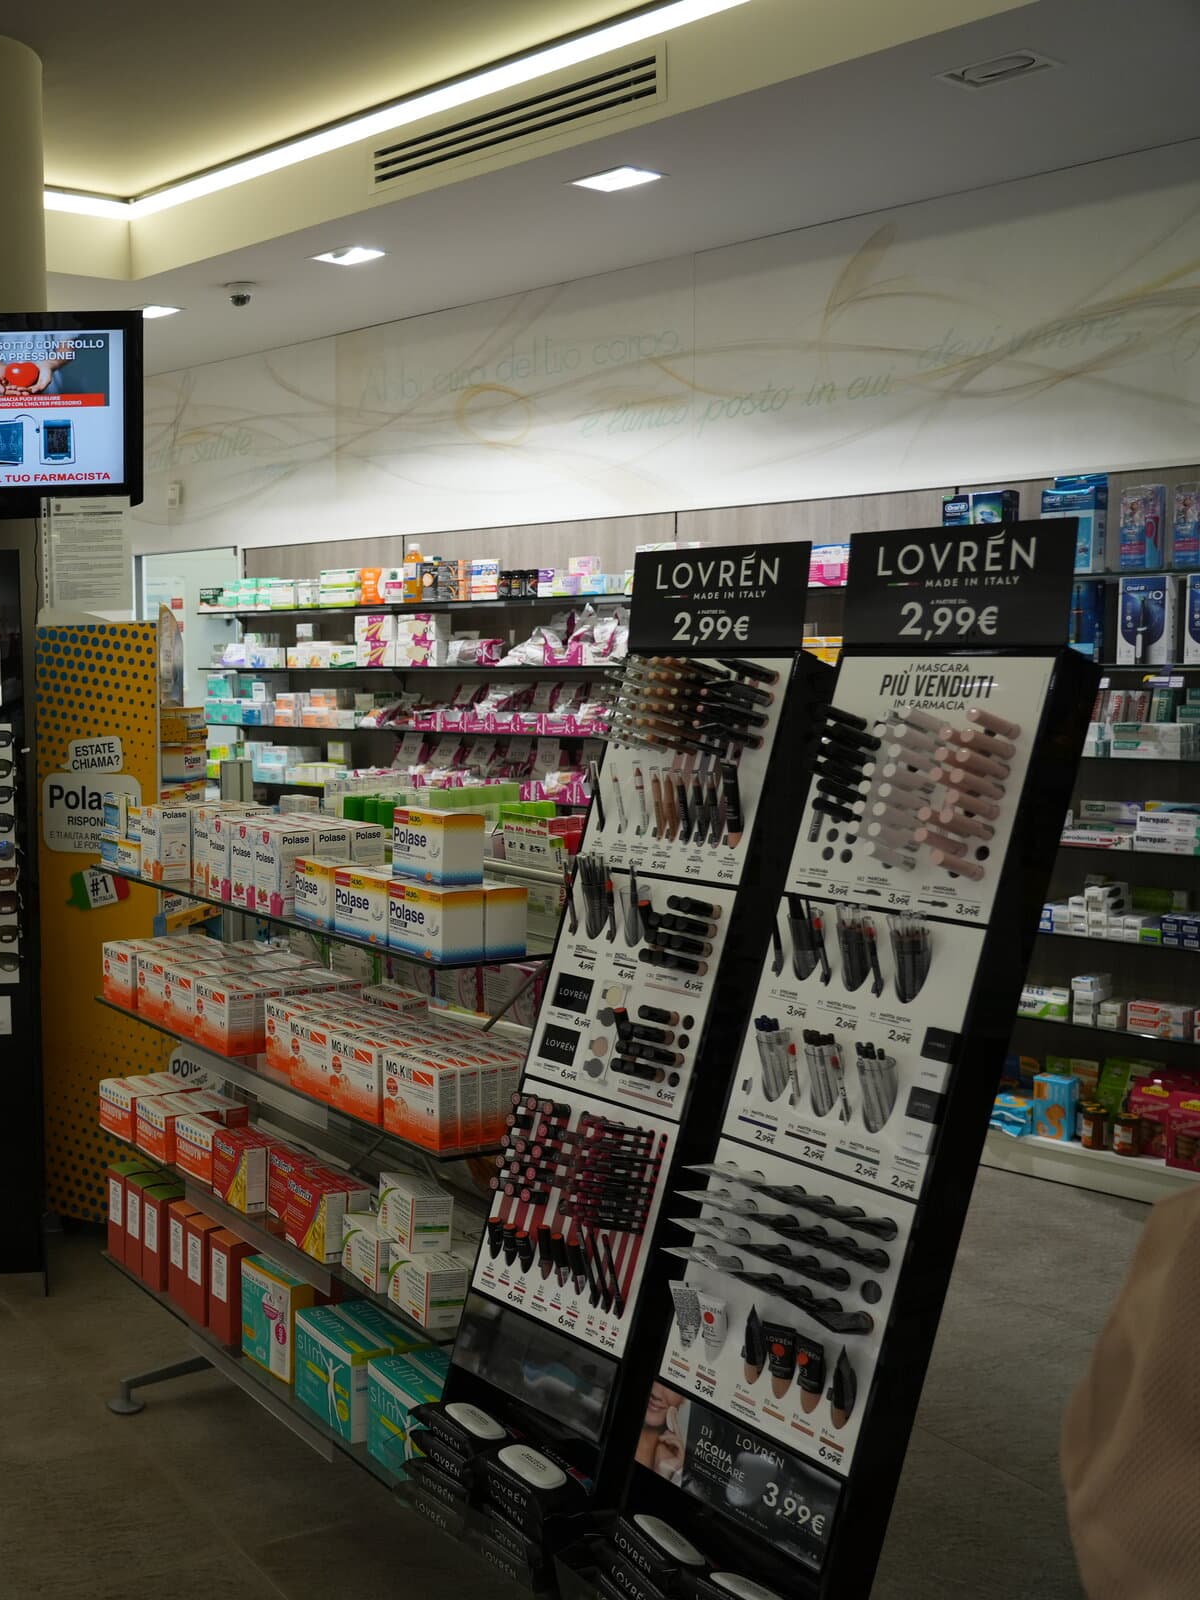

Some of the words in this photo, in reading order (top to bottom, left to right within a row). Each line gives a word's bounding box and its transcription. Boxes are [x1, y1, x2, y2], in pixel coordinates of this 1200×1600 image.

[35, 338, 104, 351] CONTROLLO
[7, 350, 76, 362] PRESSIONE!
[802, 374, 836, 407] in
[5, 473, 31, 483] TUO
[33, 472, 111, 483] FARMACISTA
[877, 529, 1037, 577] LOVRÉN
[655, 550, 781, 591] LOVRÉN
[924, 578, 960, 589] MADE
[965, 577, 980, 587] IN
[984, 575, 1020, 586] ITALY
[693, 592, 721, 601] MADE
[724, 591, 736, 600] IN
[738, 589, 767, 600] ITALY
[671, 611, 751, 647] 2,99€
[898, 601, 1001, 641] 2,99€
[920, 662, 970, 673] MASCARA
[879, 668, 908, 698] PIÙ
[909, 674, 995, 699] VENDUTI
[907, 699, 966, 712] FARMACIA
[74, 741, 115, 758] ESTATE
[71, 754, 121, 771] CHIAMA?
[184, 754, 201, 767] Polase
[48, 784, 103, 811] Pola
[162, 811, 187, 819] Polase
[1139, 815, 1170, 826] Biorepair
[141, 825, 156, 837] Polase
[319, 833, 346, 843] Polase
[355, 829, 381, 840] Polase
[394, 825, 427, 848] Polase
[209, 839, 225, 852] Polase
[282, 835, 310, 846] Polase
[232, 845, 251, 859] Polase
[255, 851, 275, 865] Polase
[90, 876, 109, 897] #1
[295, 874, 318, 896] Polase
[336, 887, 370, 911] Polase
[389, 900, 425, 926] Polase
[310, 1309, 345, 1333] slim
[384, 1358, 424, 1385] slim
[696, 1438, 733, 1465] ACQUA
[693, 1450, 745, 1484] MICELLARE
[762, 1481, 826, 1537] 3,99€
